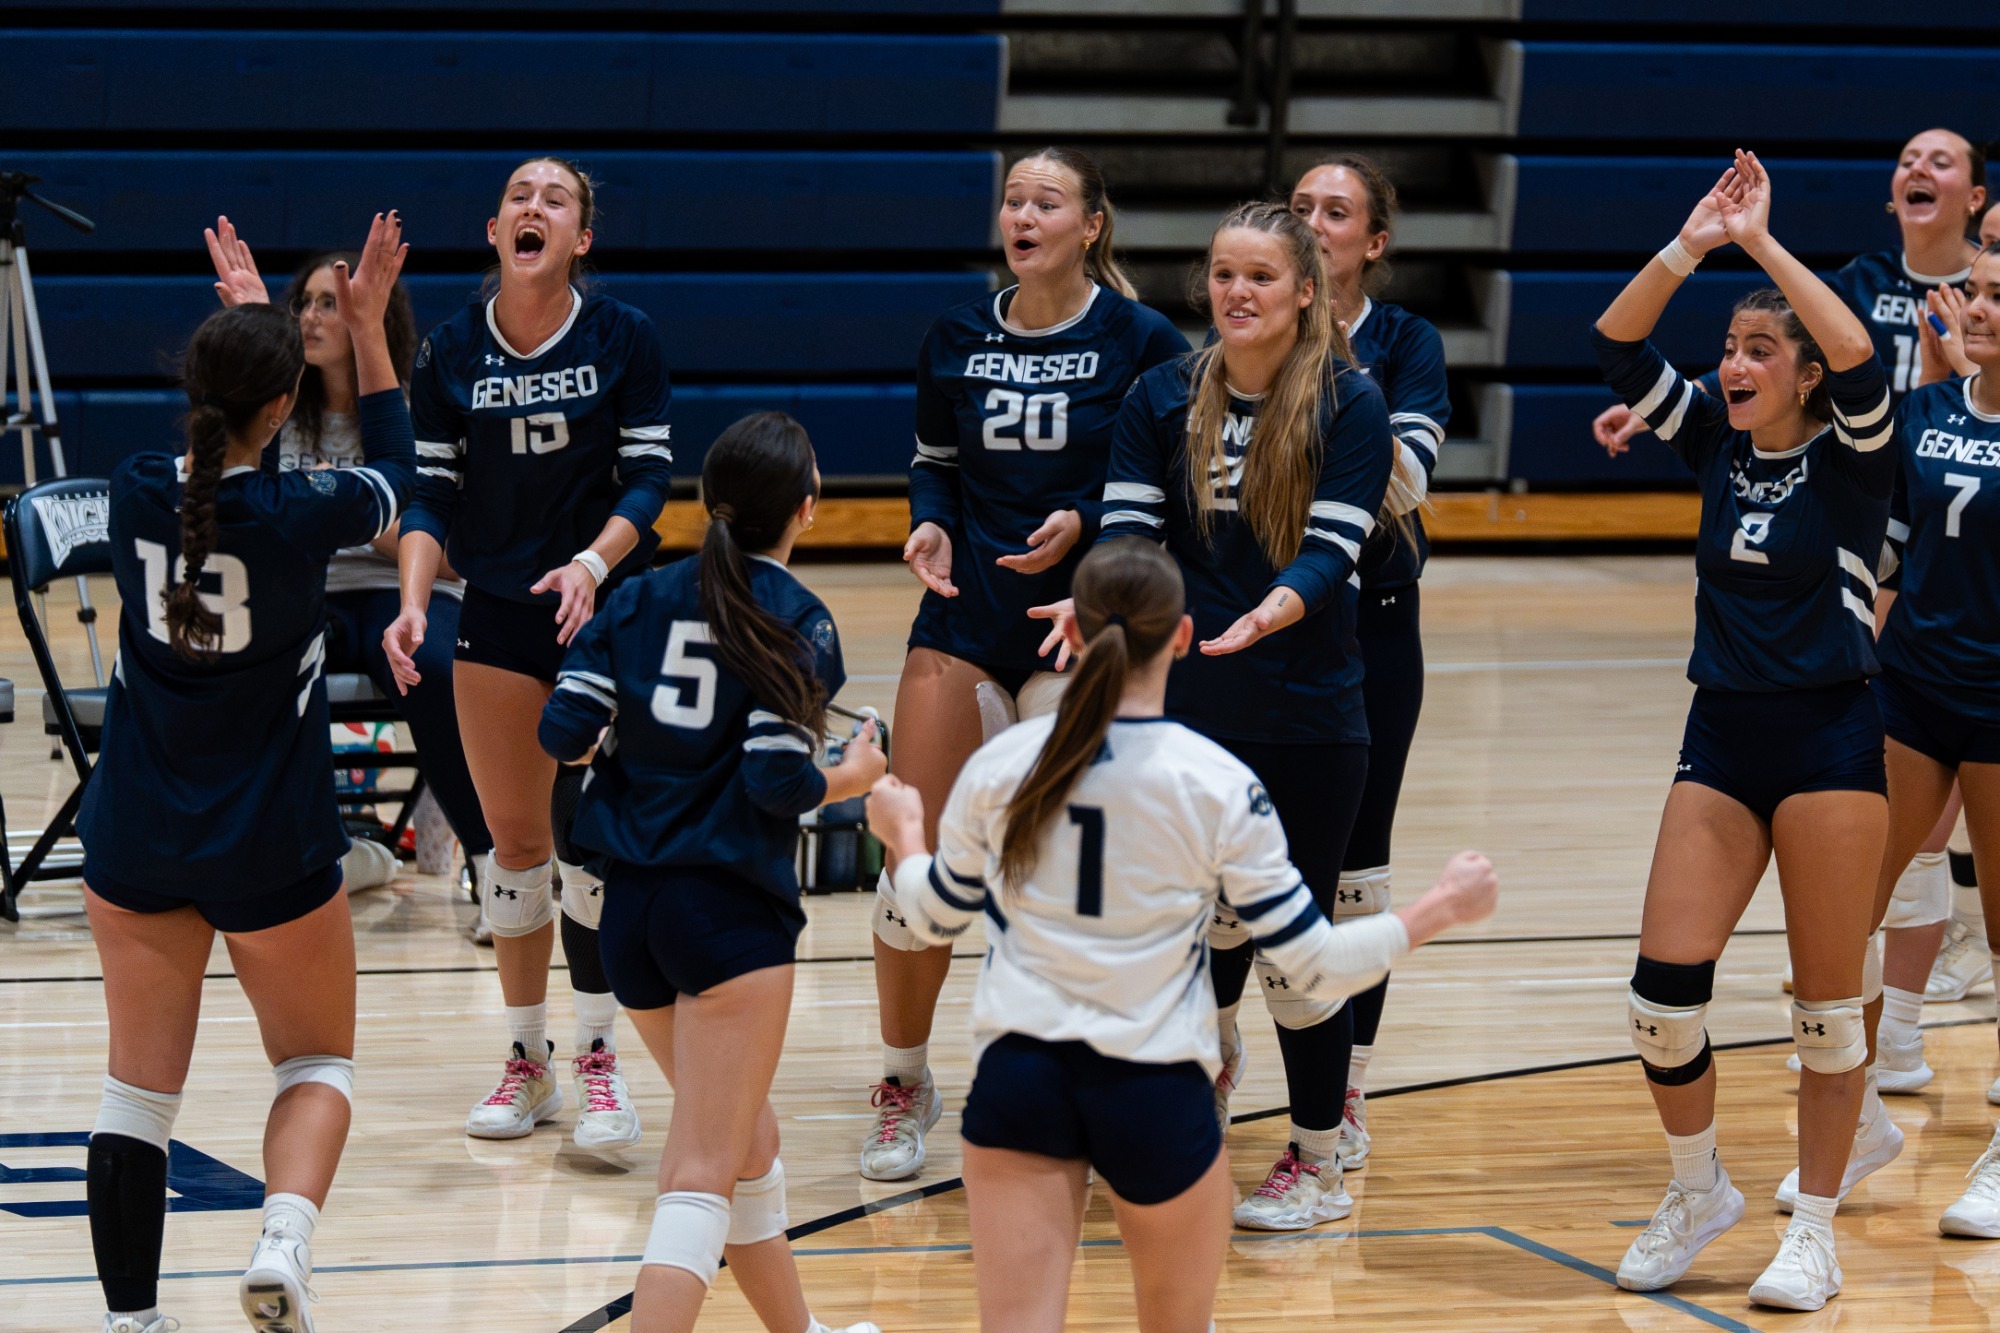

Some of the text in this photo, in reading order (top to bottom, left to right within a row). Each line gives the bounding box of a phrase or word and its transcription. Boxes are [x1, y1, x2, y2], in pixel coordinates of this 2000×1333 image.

[472, 364, 598, 411] GENESEO
[964, 351, 1099, 384] GENESEO
[983, 388, 1070, 451] 20
[1916, 428, 2000, 468] GENES
[1944, 472, 1981, 538] 7
[1730, 512, 1775, 565] 2
[651, 620, 720, 730] 5
[1067, 803, 1106, 918] 1
